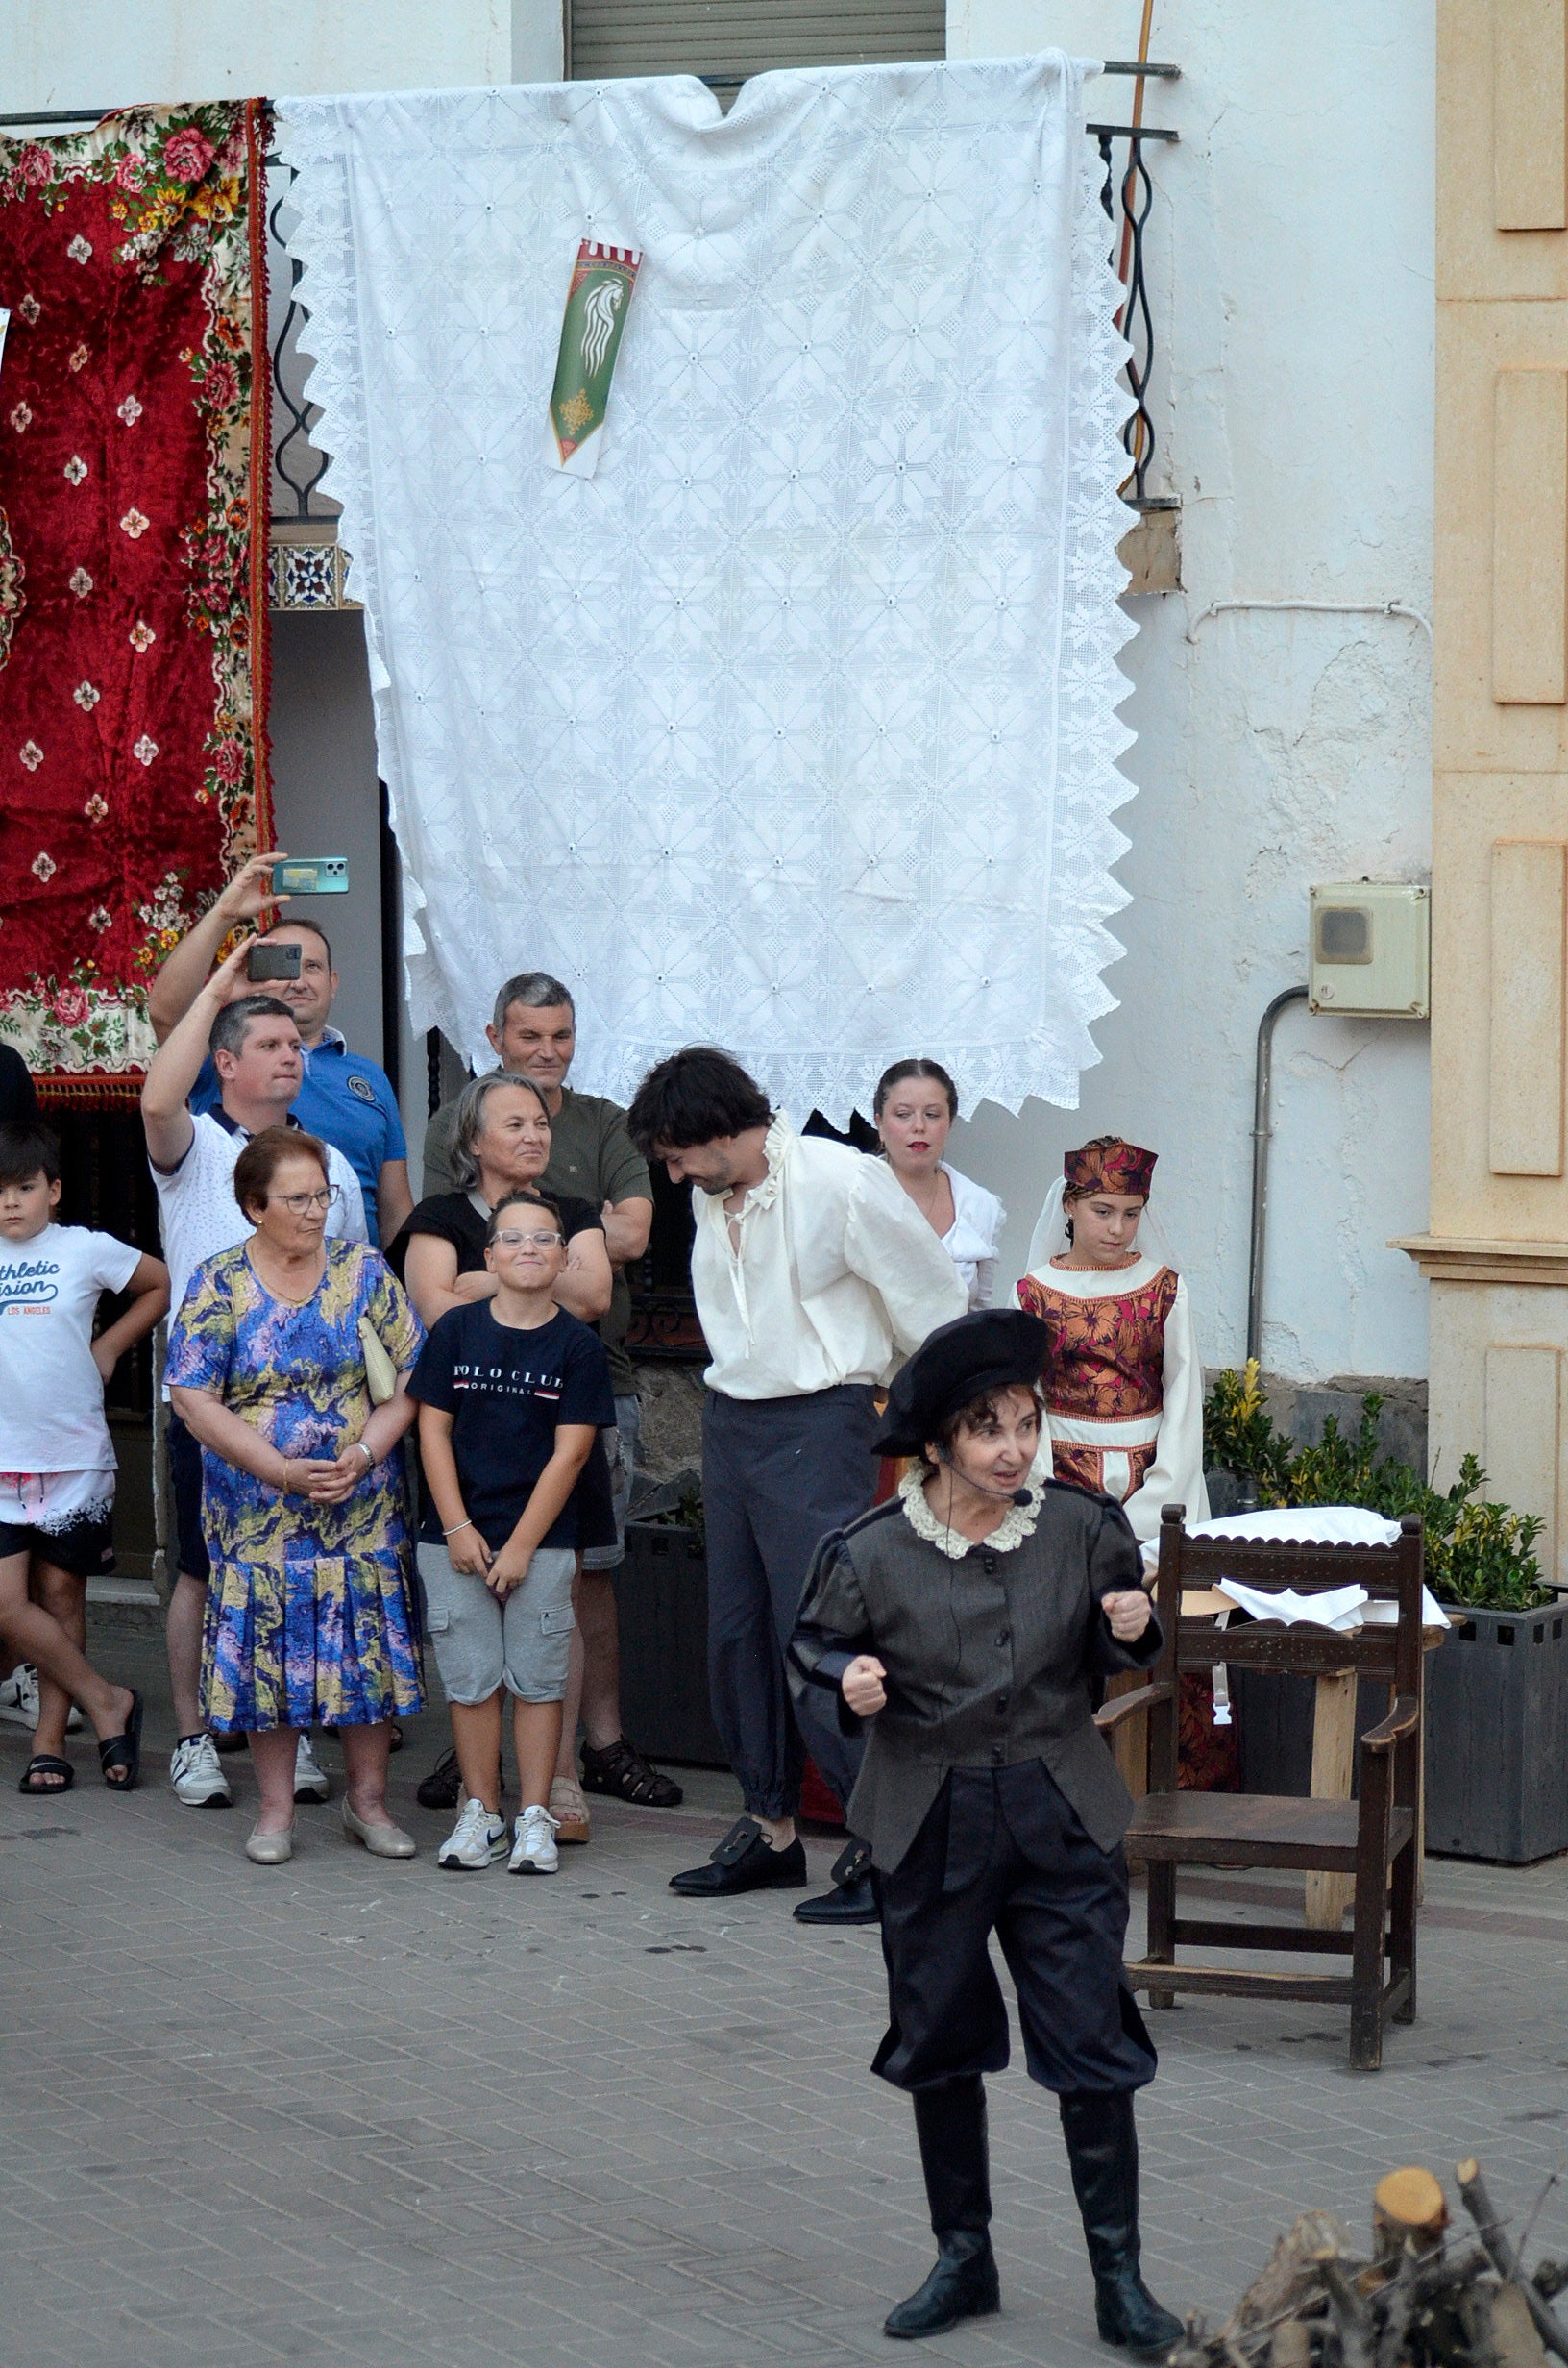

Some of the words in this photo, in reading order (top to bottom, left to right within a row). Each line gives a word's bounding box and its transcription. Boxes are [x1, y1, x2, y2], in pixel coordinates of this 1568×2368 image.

[8, 1307, 20, 1316] LOS
[23, 1306, 51, 1315] ANGELES
[453, 1365, 502, 1378] POLO
[471, 1382, 532, 1395] ORIGINAL
